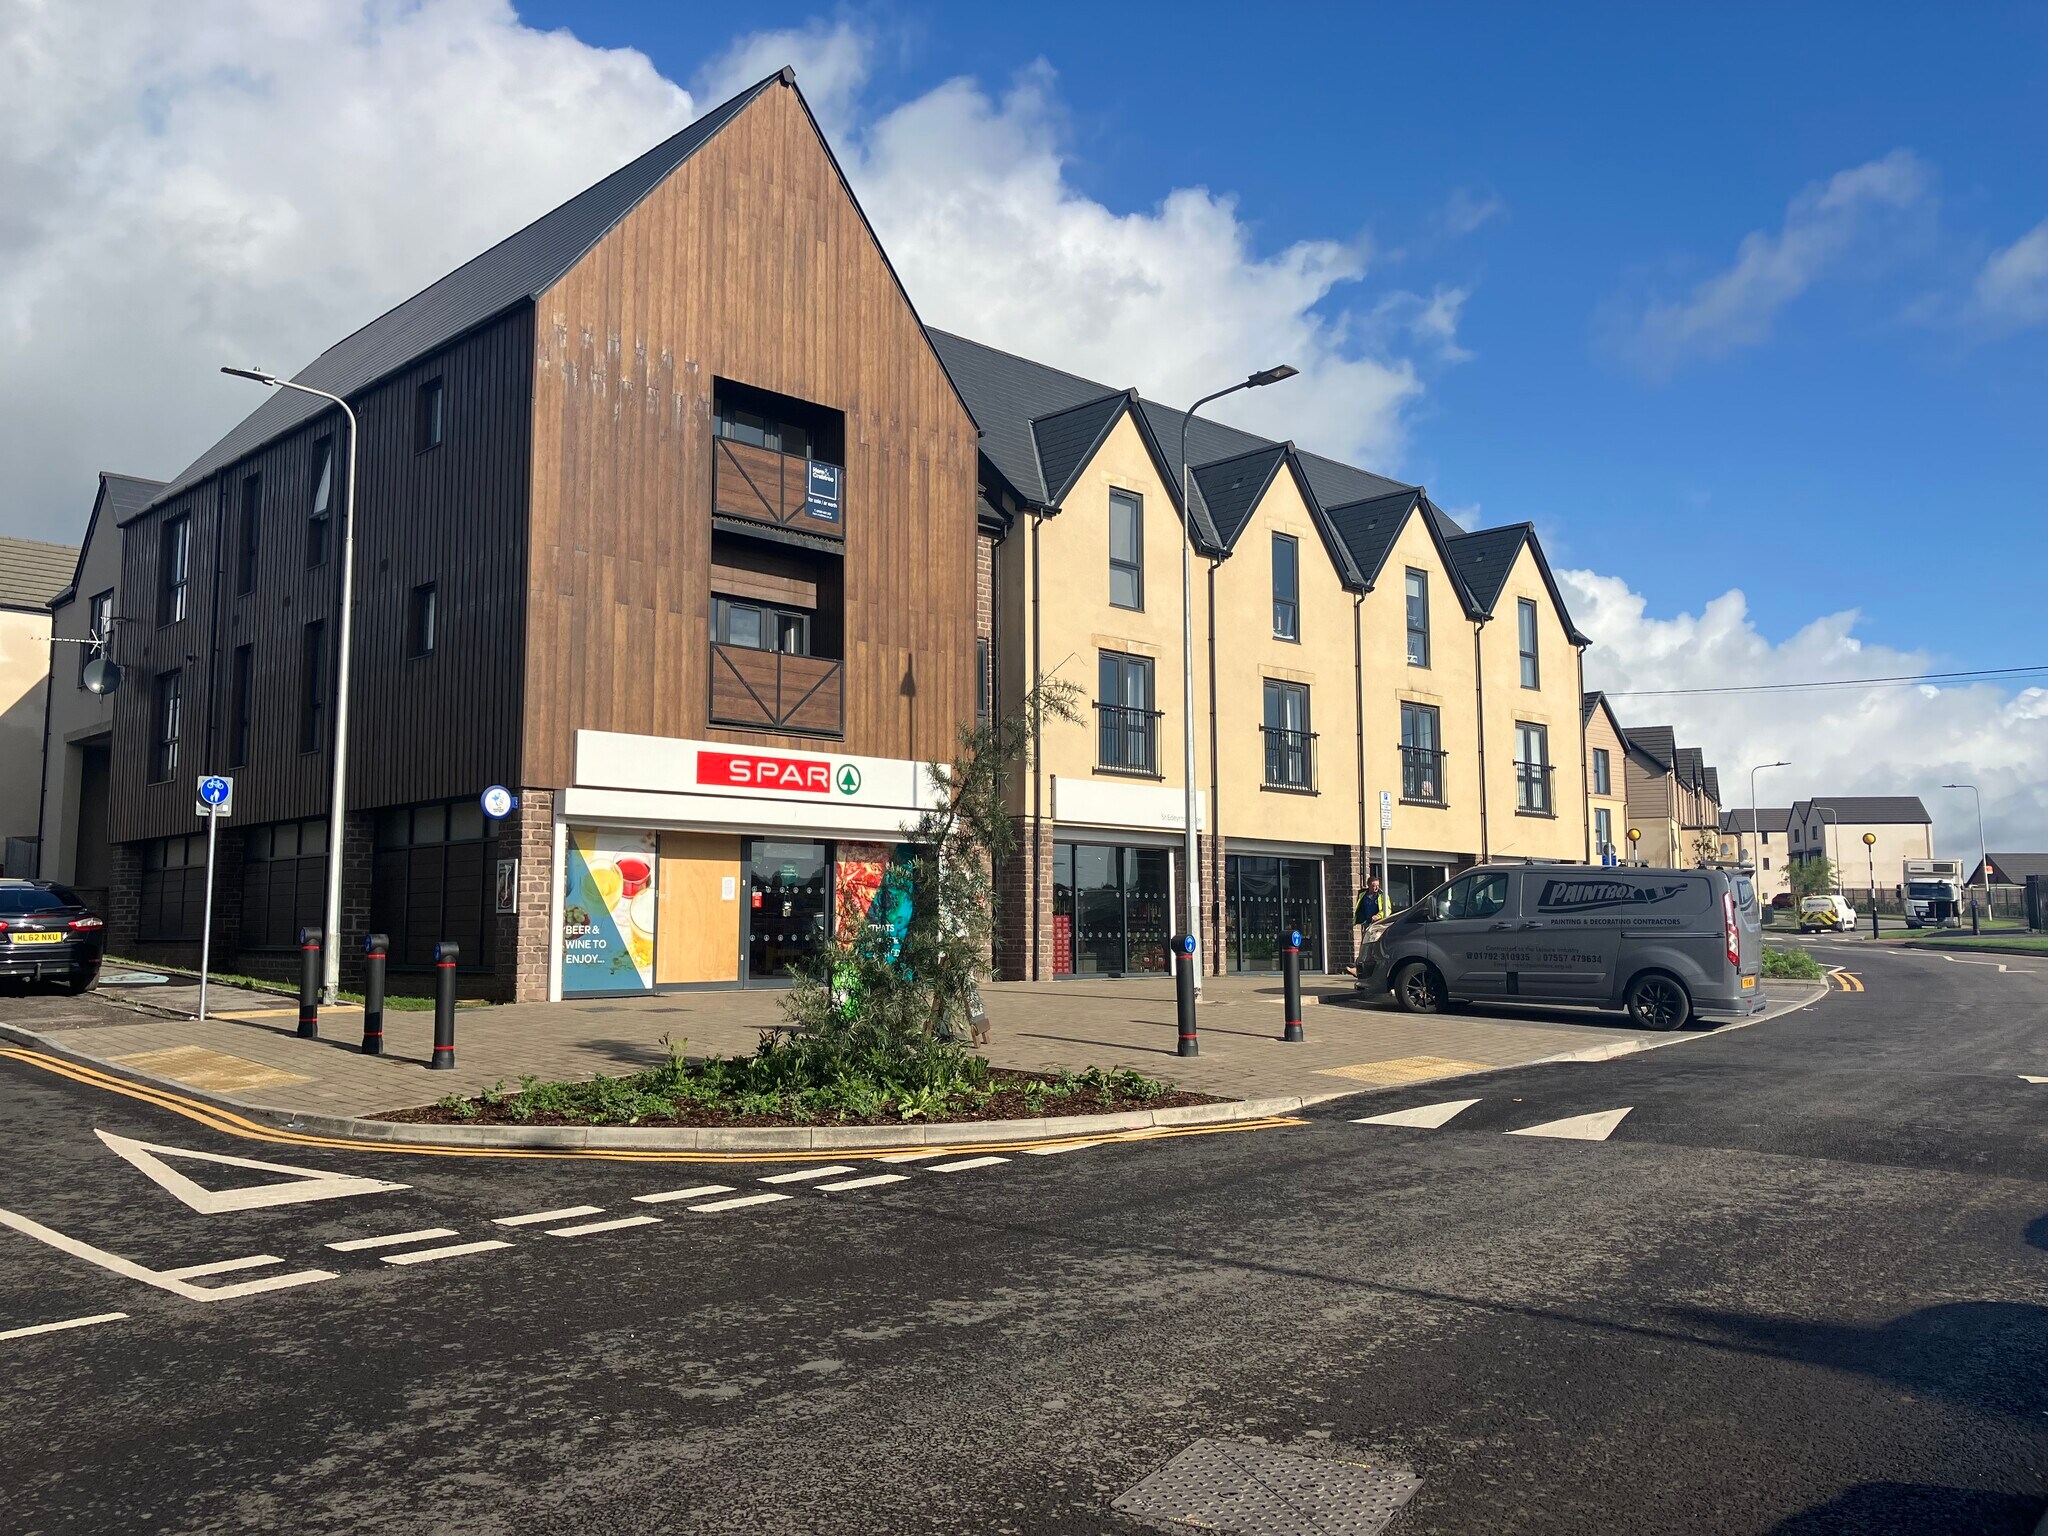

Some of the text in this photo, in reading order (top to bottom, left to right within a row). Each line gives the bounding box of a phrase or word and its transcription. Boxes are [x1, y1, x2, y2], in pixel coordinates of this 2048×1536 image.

[729, 759, 828, 788] SPAR
[1549, 882, 1636, 905] PAINTBOX
[1590, 918, 1632, 926] DECORATING
[1633, 918, 1681, 926] CONTRACTORS
[591, 925, 600, 935] &
[41, 933, 58, 942] NXU
[565, 939, 607, 949] WINE TO
[566, 954, 605, 964] ENJOY...
[1473, 951, 1498, 960] 01792
[1543, 953, 1568, 962] 07557
